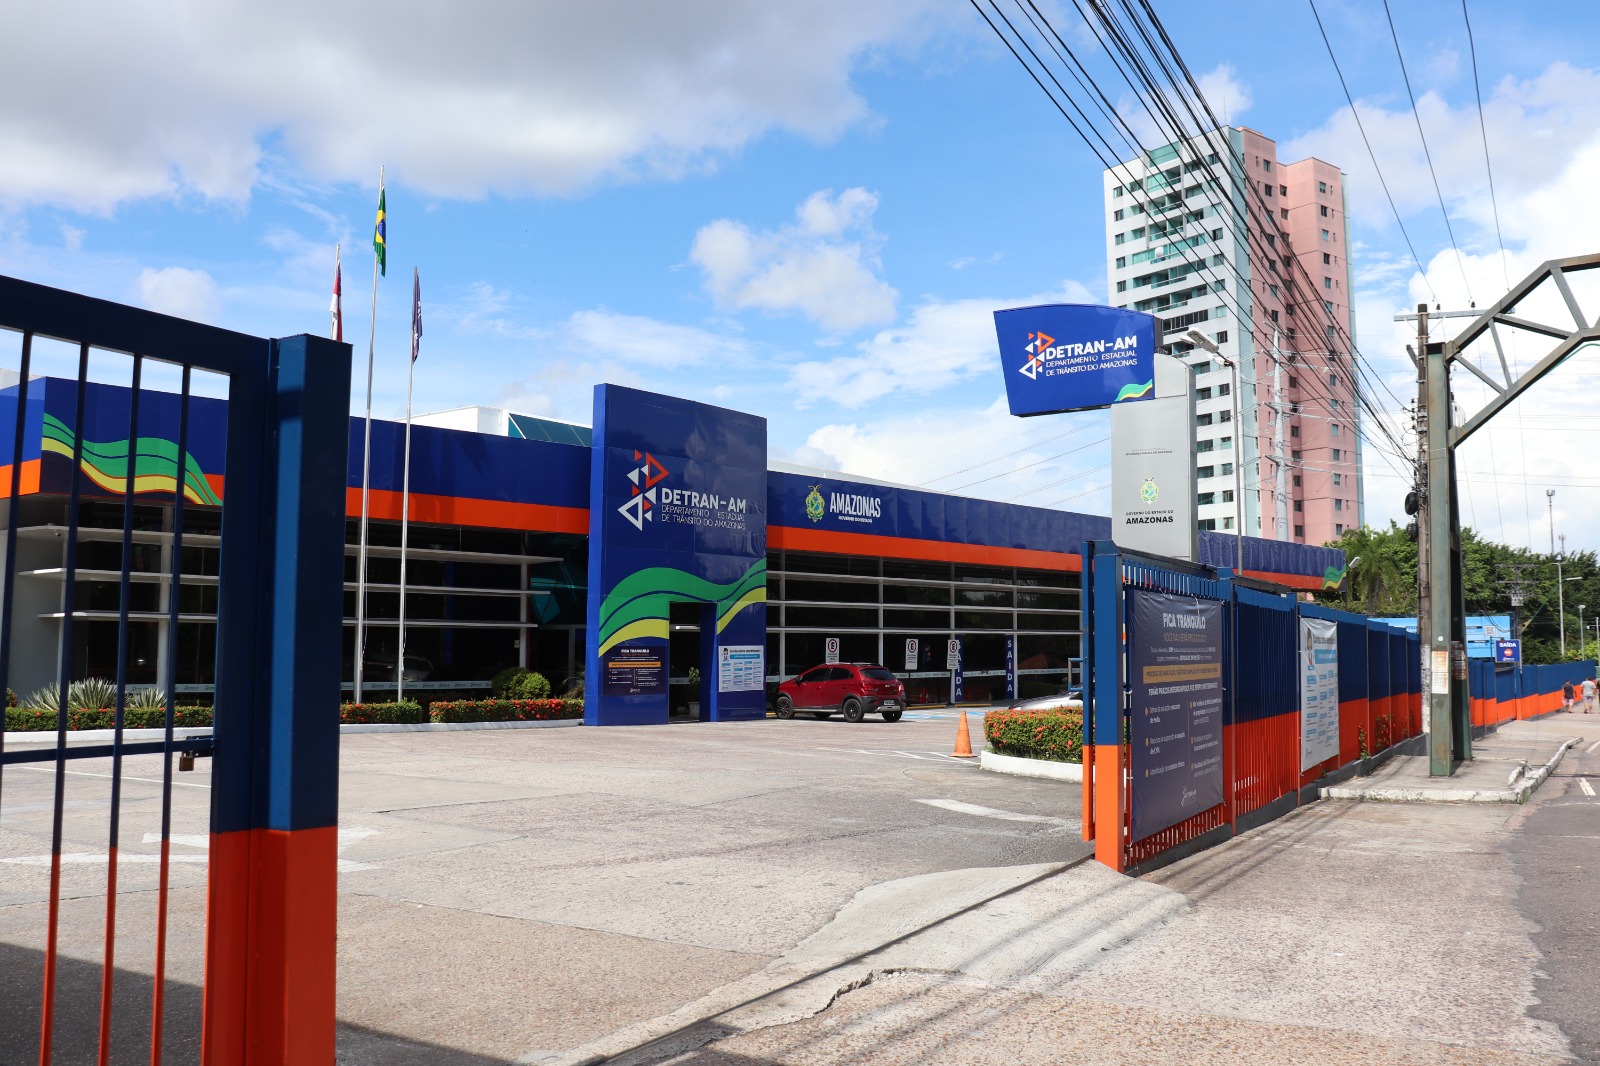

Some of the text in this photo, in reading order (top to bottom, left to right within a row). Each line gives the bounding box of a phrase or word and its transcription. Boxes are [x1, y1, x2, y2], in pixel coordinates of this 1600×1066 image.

[1046, 335, 1137, 360] DETRAN-AM
[1046, 350, 1137, 368] DEPARTAMENTO ESTADUAL
[1056, 364, 1086, 375] TRÂNSITO
[1099, 359, 1137, 370] AMAZONAS
[662, 487, 746, 514] DETRAN-AM
[830, 492, 881, 518] AMAZONAS
[662, 504, 744, 521] DEPARTAMENTO ESTADUAL
[1126, 516, 1174, 524] AMAZONAS
[662, 514, 670, 522] DE
[673, 514, 702, 525] TRÂNSITO
[715, 520, 746, 530] AMAZONAS
[1163, 612, 1206, 629] FICA TRANQUILO
